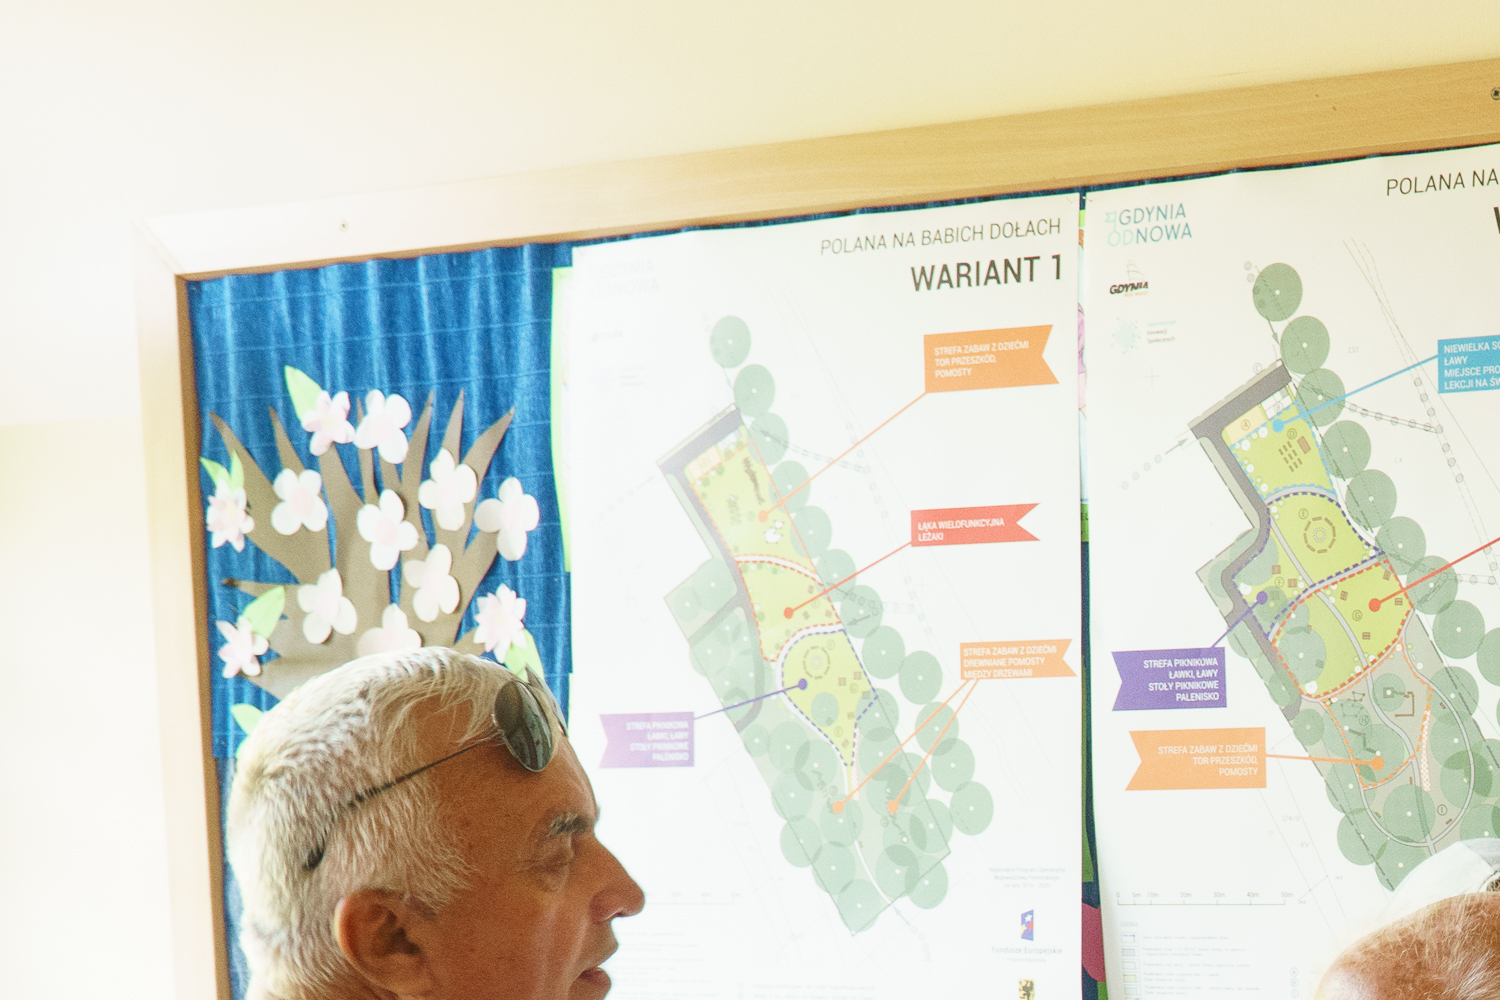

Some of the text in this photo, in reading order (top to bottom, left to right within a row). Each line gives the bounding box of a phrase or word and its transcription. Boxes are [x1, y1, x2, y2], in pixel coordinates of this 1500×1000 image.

[1386, 172, 1466, 196] POLANA
[1472, 168, 1499, 187] NA
[1119, 202, 1186, 226] GDYNIA
[820, 217, 1061, 255] POLANA NA BABICH DOŁACH
[910, 253, 1061, 291] WARIANT 1
[1109, 281, 1149, 295] GDYNIA
[934, 339, 1030, 356] STREFA ZABAW Z DZIEĆMI
[1443, 342, 1490, 353] NIEWIELKA
[935, 357, 951, 367] TOR
[1443, 355, 1468, 366] ŁAWY
[935, 367, 973, 378] POMOSTY
[1444, 366, 1481, 378] MIEJSCE
[1444, 379, 1473, 390] LEKCJI
[1475, 378, 1488, 388] NA
[938, 518, 1006, 530] WIELOFUNKCYJNA
[963, 643, 1057, 657] STREFA ZABAW Z DZIEĆMI
[963, 656, 1046, 668] DREWNIANE POMOSTY
[1143, 657, 1219, 669] STREFA PIKNIKOWA
[993, 668, 1033, 678] DRZEWAMI
[1168, 669, 1219, 680] ŁAWKI, ŁAWY
[1148, 680, 1219, 692] STOŁY PIKNIKOWE
[1176, 692, 1220, 702] PALENISKO
[1158, 743, 1258, 755] STREFA ZABAW Z DZIEĆMI
[1193, 756, 1209, 766] TOR
[1219, 767, 1259, 776] POMOSTY
